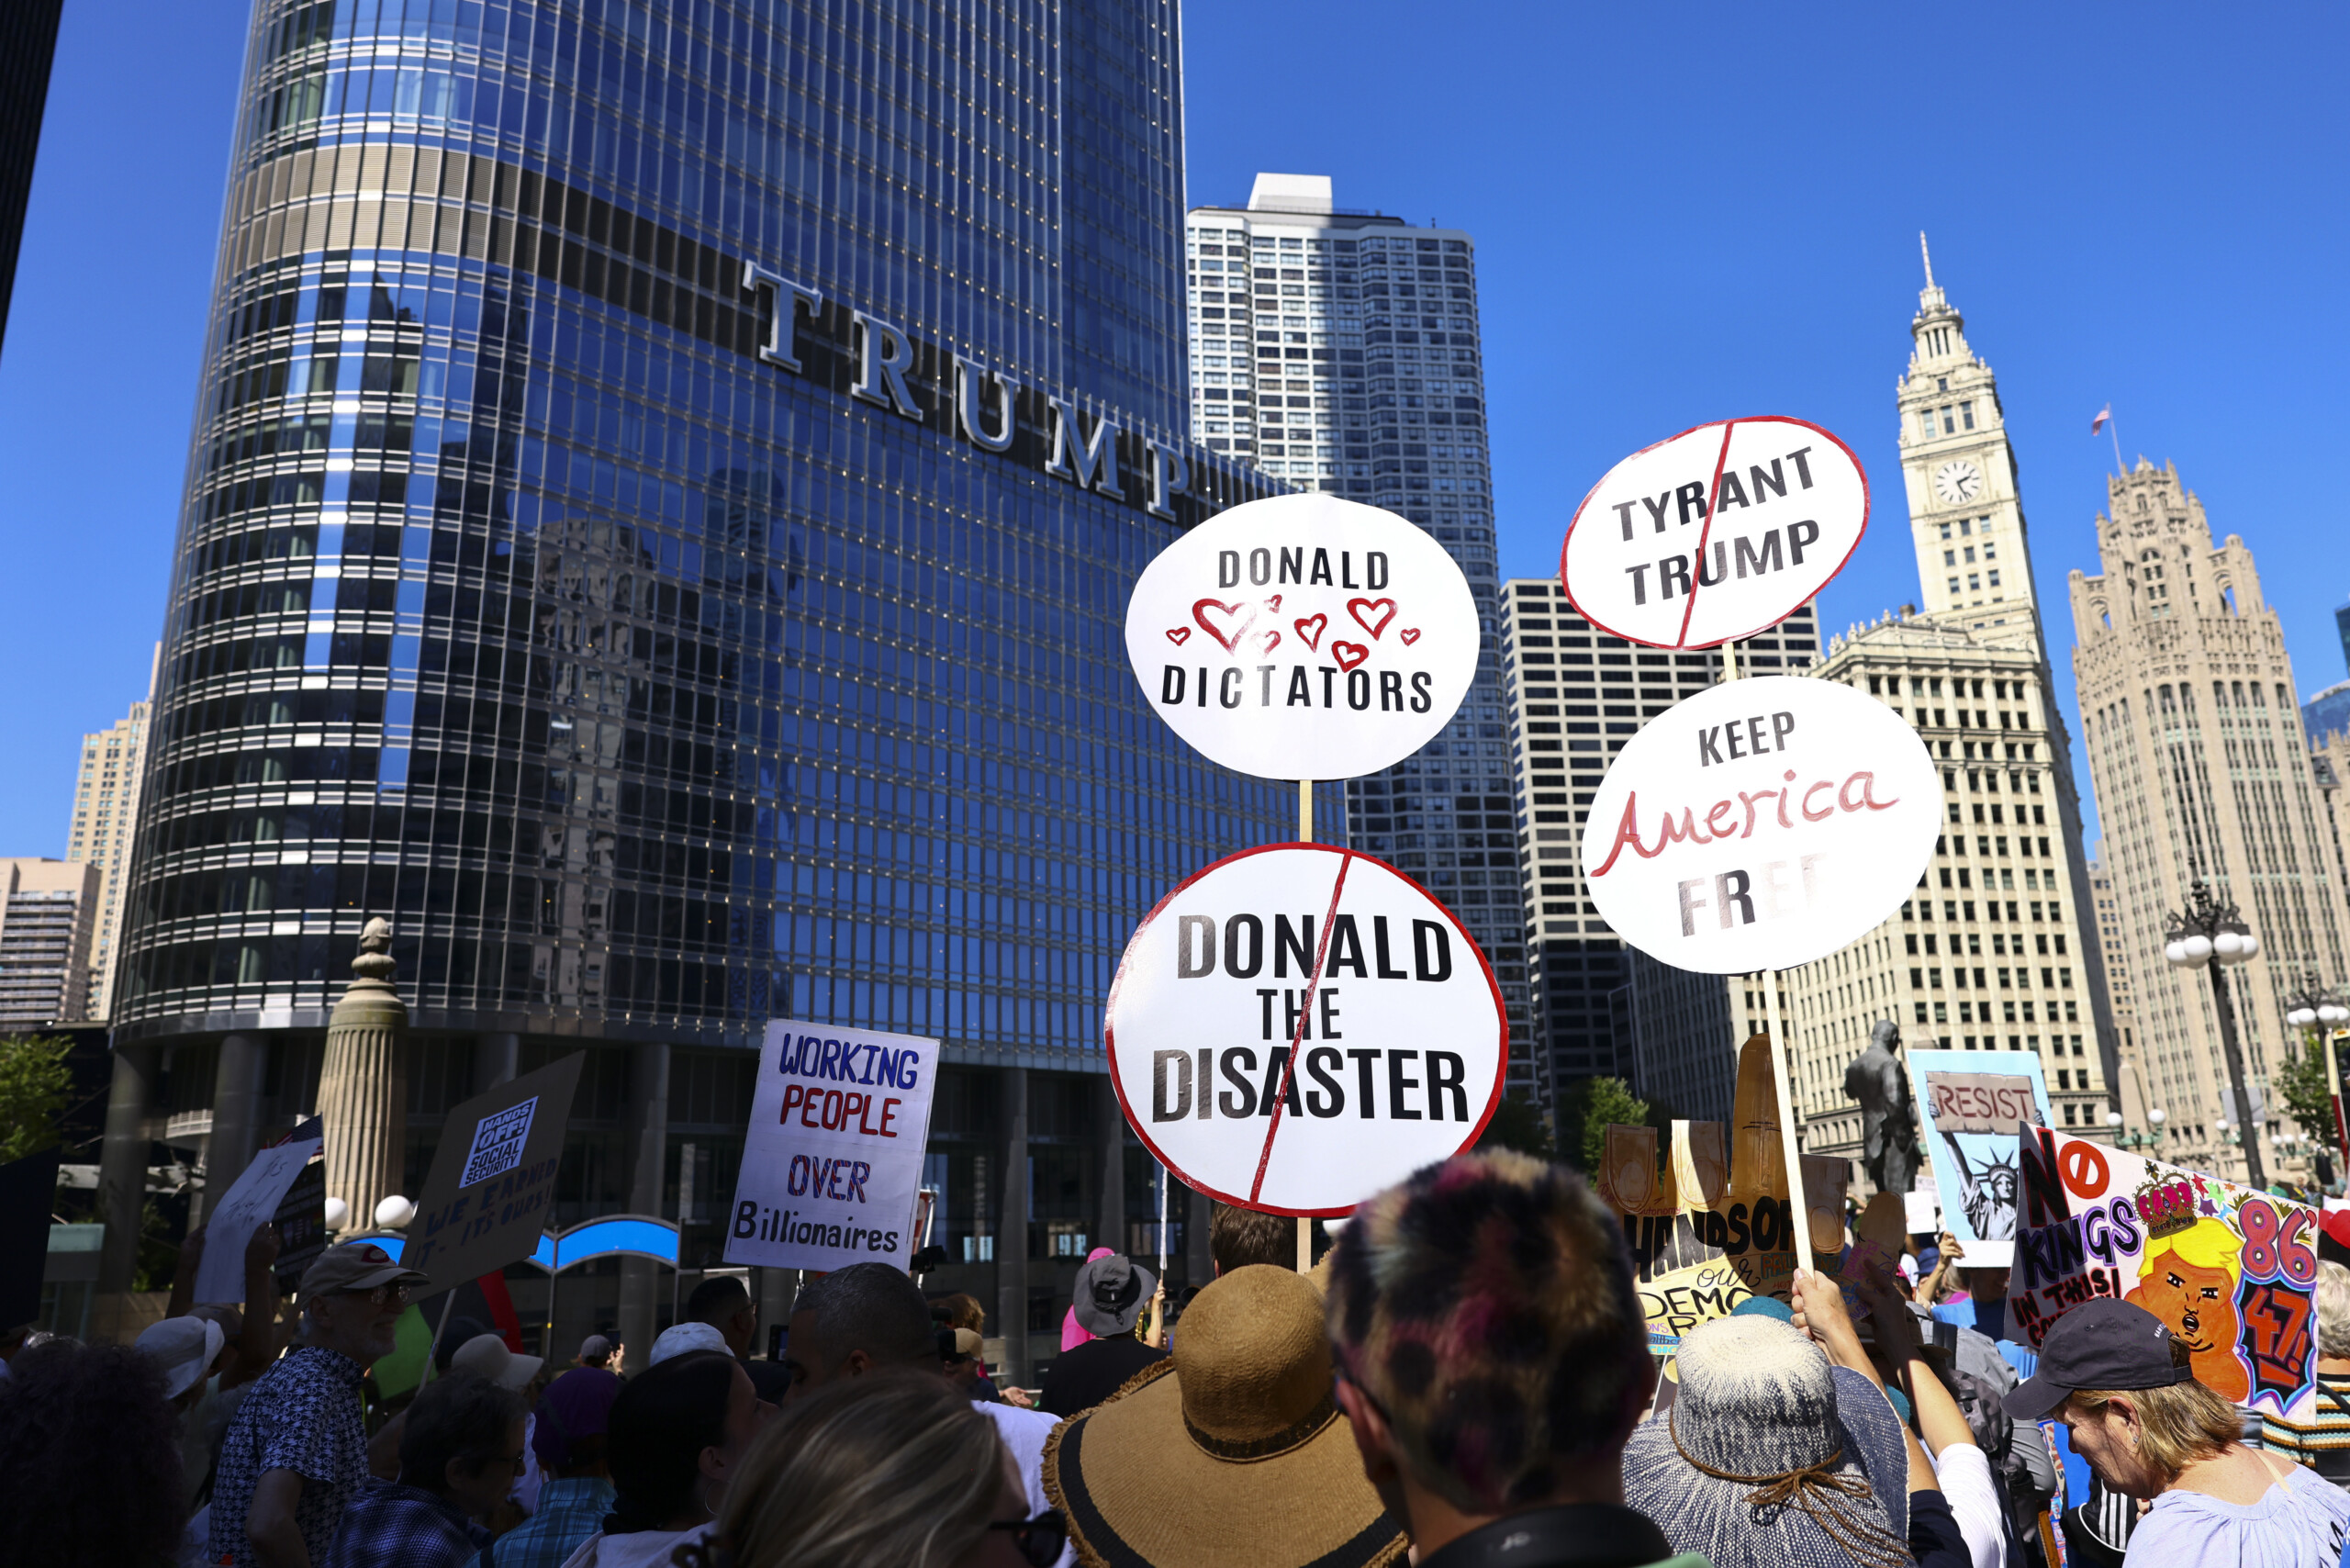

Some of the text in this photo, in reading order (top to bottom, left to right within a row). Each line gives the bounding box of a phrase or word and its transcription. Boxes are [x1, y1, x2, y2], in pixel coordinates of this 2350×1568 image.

[742, 259, 1191, 522] TRUMP
[1612, 446, 1814, 542] TYRANT
[1218, 546, 1389, 590] DONALD
[1625, 520, 1820, 606] TRUMP
[1161, 664, 1432, 714] DICTATORS
[1698, 711, 1796, 767] KEEP
[1590, 768, 1901, 878] America
[1177, 913, 1452, 982] DONALD
[1256, 988, 1343, 1040] THE
[779, 1033, 920, 1090] WORKING
[1152, 1046, 1470, 1124] DISASTER
[483, 1103, 531, 1132] HANDS
[779, 1084, 901, 1137] PEOPLE
[1936, 1085, 2030, 1120] RESIST
[469, 1138, 520, 1171] SOCIAL
[479, 1116, 528, 1149] OFF!
[464, 1153, 518, 1185] SECURITY
[788, 1154, 870, 1204] OVER
[425, 1158, 558, 1238] WE EARNED
[500, 1184, 551, 1226] OURS!
[733, 1200, 899, 1252] Billionaires
[1624, 1203, 1751, 1283] HANDS
[2016, 1196, 2142, 1290] KINGS
[1696, 1258, 1762, 1288] our
[2010, 1289, 2042, 1328] IN
